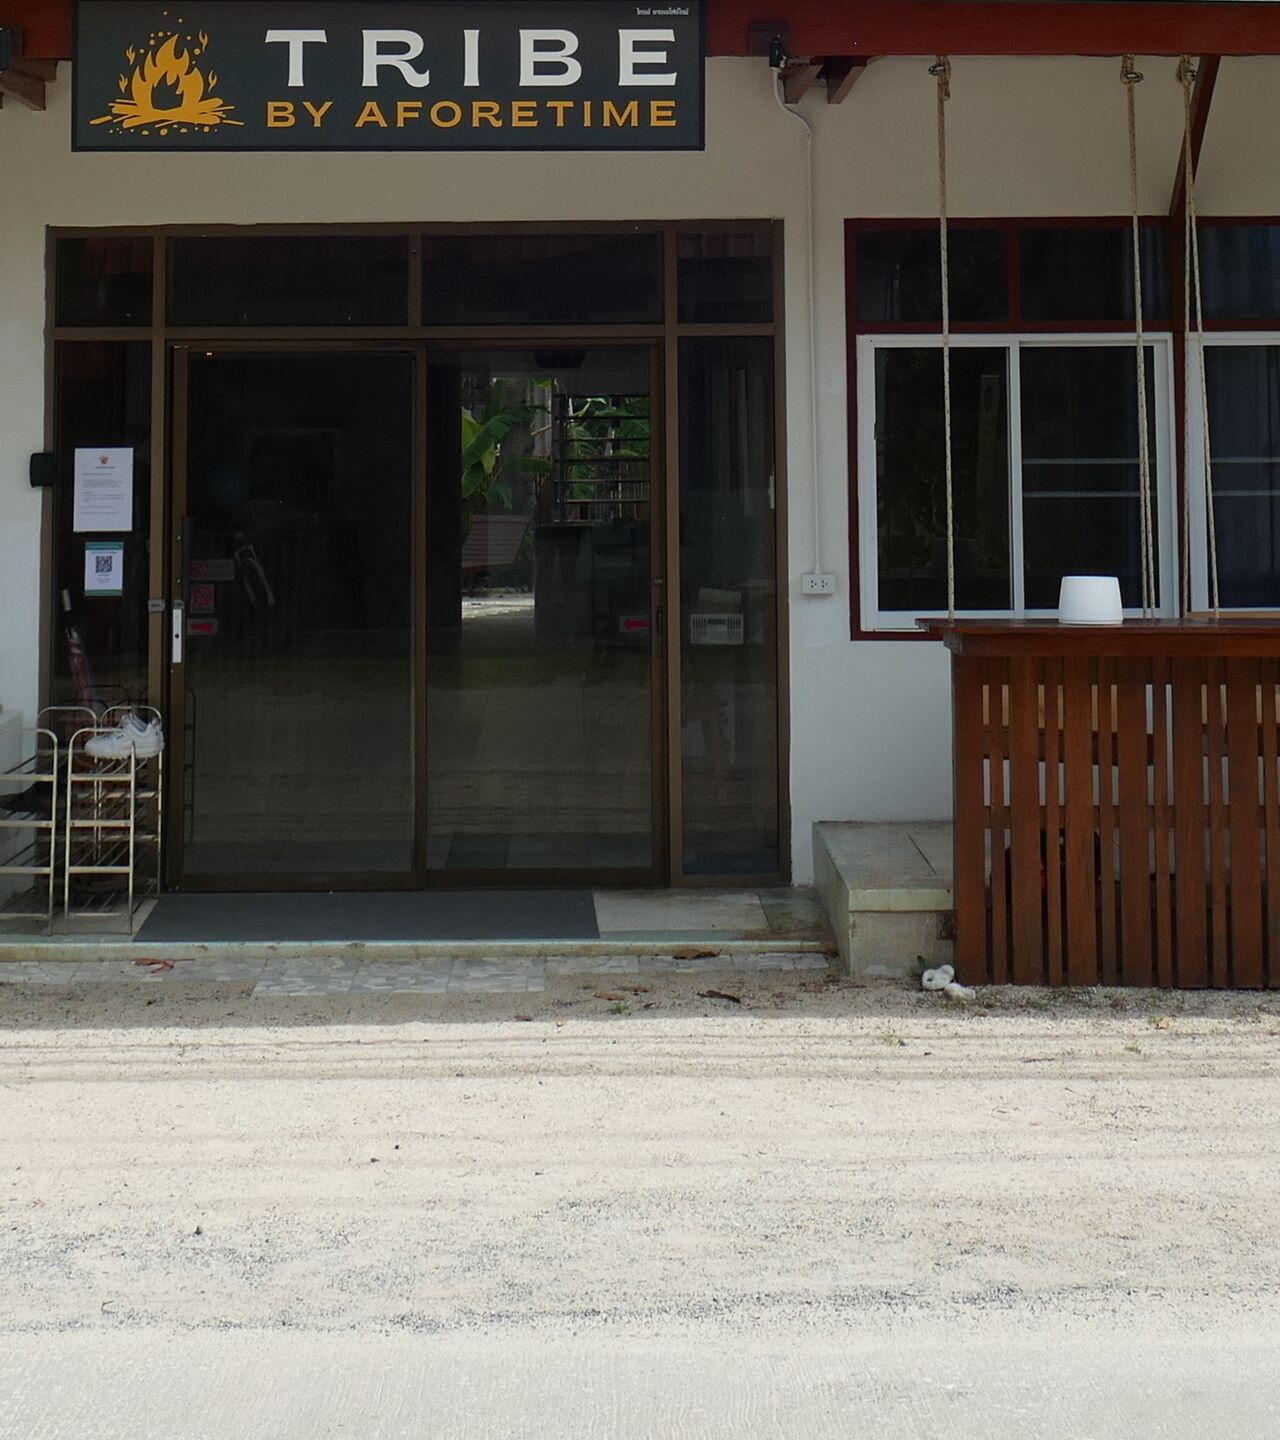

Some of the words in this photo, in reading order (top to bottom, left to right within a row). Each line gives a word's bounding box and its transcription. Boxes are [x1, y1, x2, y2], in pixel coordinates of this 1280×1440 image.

[264, 28, 677, 88] TRIBE
[266, 101, 333, 128] BY
[354, 100, 677, 128] AFORETIME
